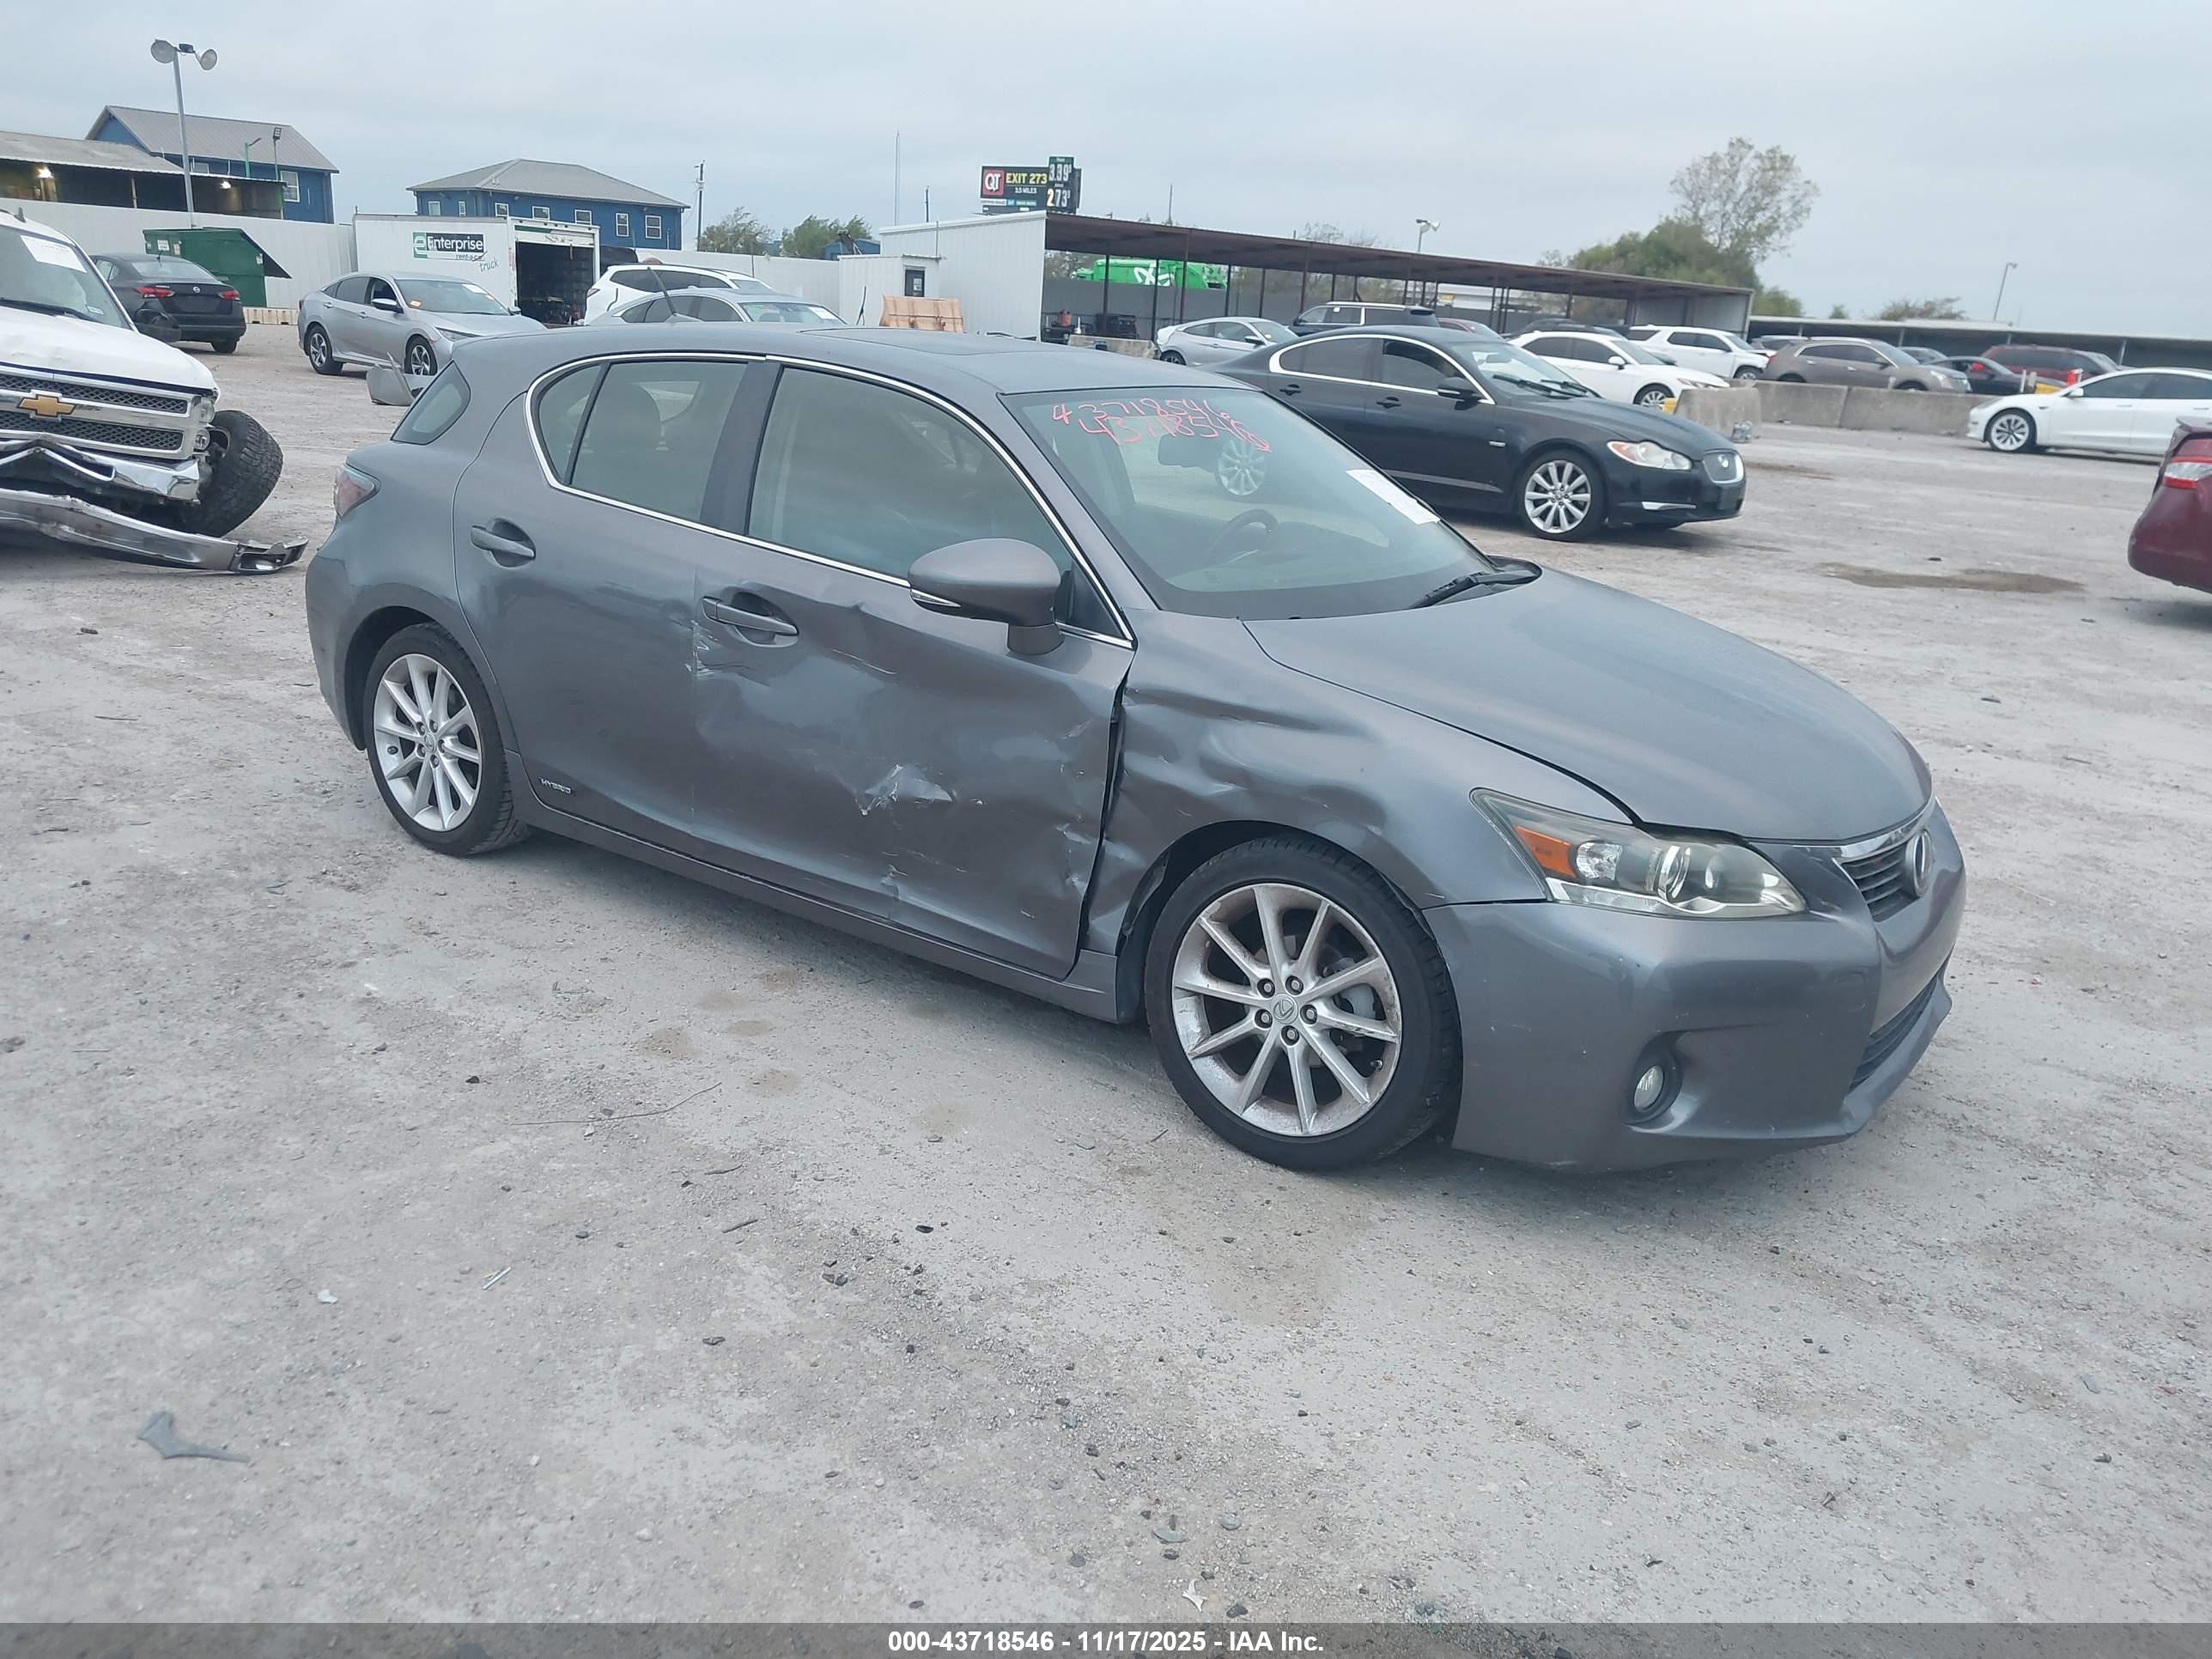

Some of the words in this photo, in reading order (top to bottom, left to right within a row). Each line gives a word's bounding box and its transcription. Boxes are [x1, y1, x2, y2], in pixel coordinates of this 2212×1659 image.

[984, 173, 1001, 191] QT
[1006, 173, 1028, 184] EXIT
[1029, 173, 1048, 184] 273
[427, 235, 483, 252] Enterprise
[479, 256, 500, 272] truck
